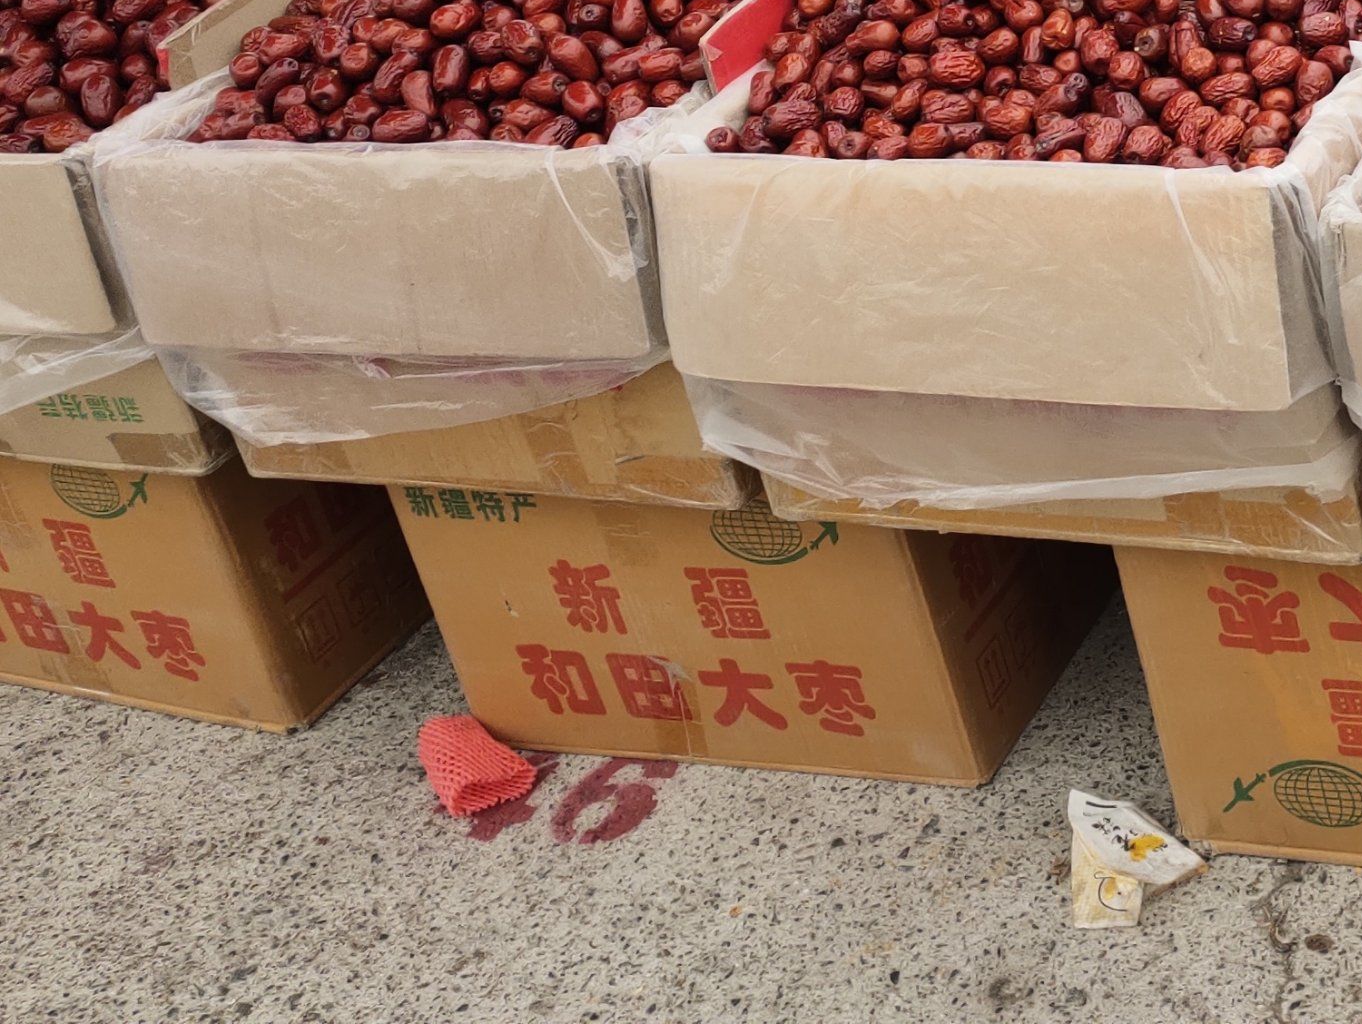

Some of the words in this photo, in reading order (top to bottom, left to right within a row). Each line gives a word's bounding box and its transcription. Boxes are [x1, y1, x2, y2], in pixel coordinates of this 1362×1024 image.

[403, 486, 537, 524] 新疆特产
[0, 588, 205, 681] 田大枣
[548, 559, 771, 639] 新疆
[515, 643, 875, 736] 和田大枣
